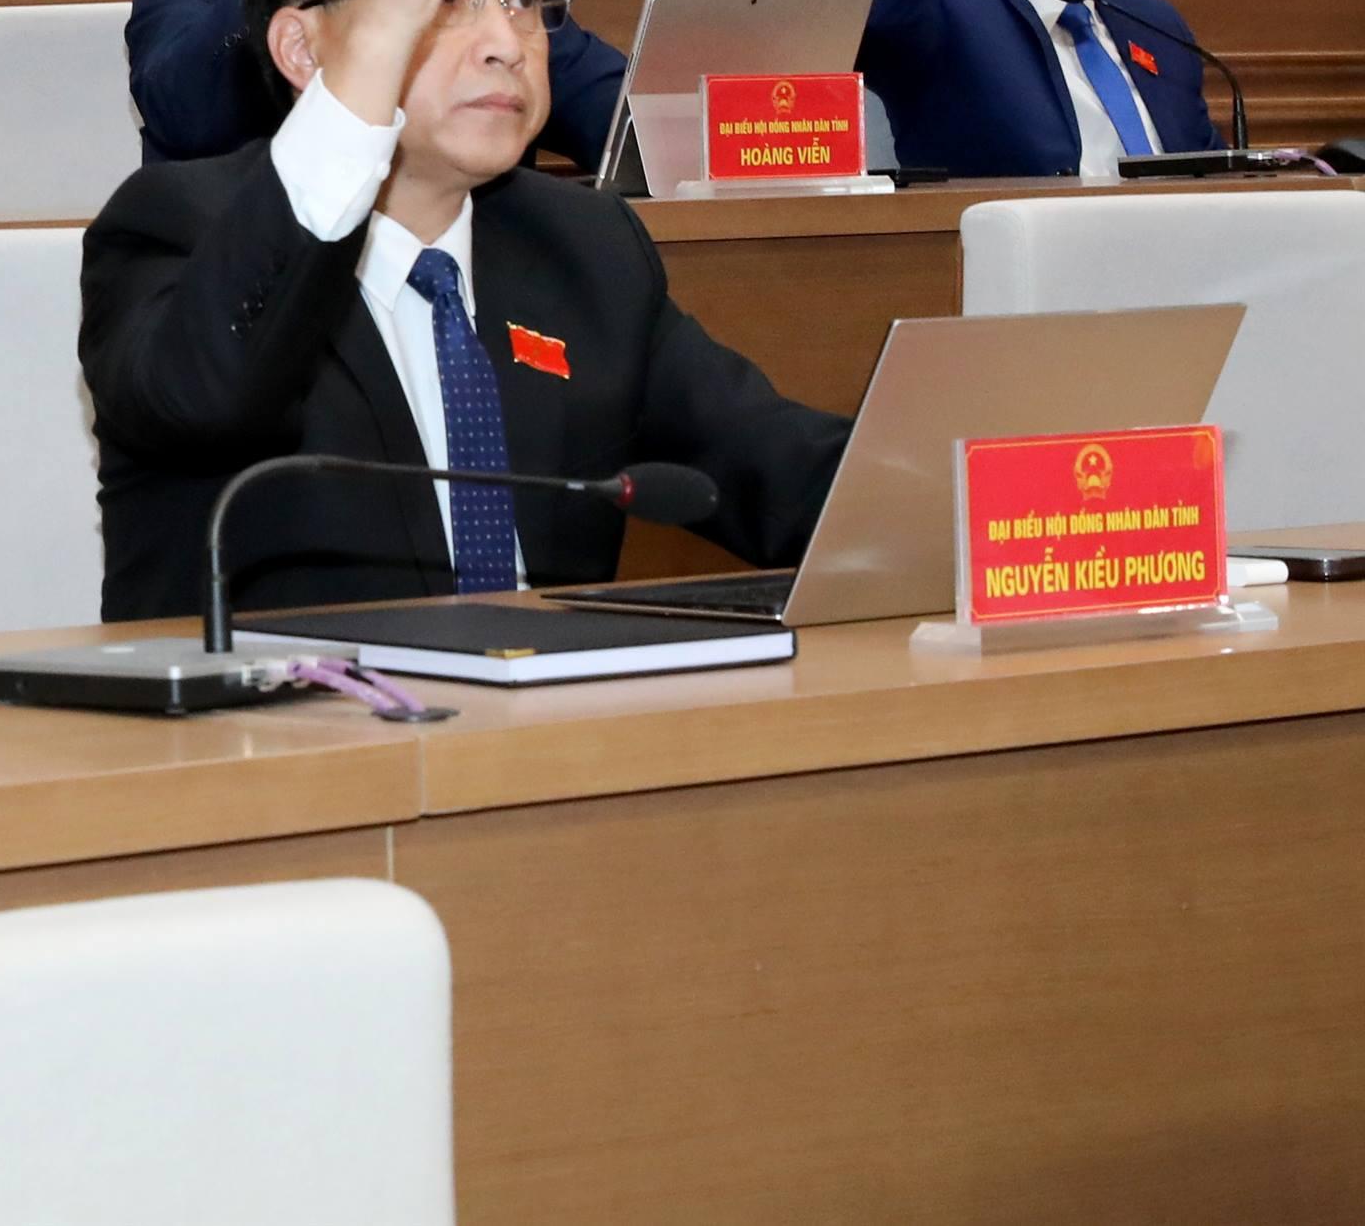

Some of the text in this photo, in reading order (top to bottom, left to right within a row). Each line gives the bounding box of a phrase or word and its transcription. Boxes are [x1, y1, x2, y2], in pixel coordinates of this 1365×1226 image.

[741, 137, 830, 166] HOÀNG VIỄN
[986, 545, 1205, 598] NGUYỄN KIỀU PHƯƠNG
